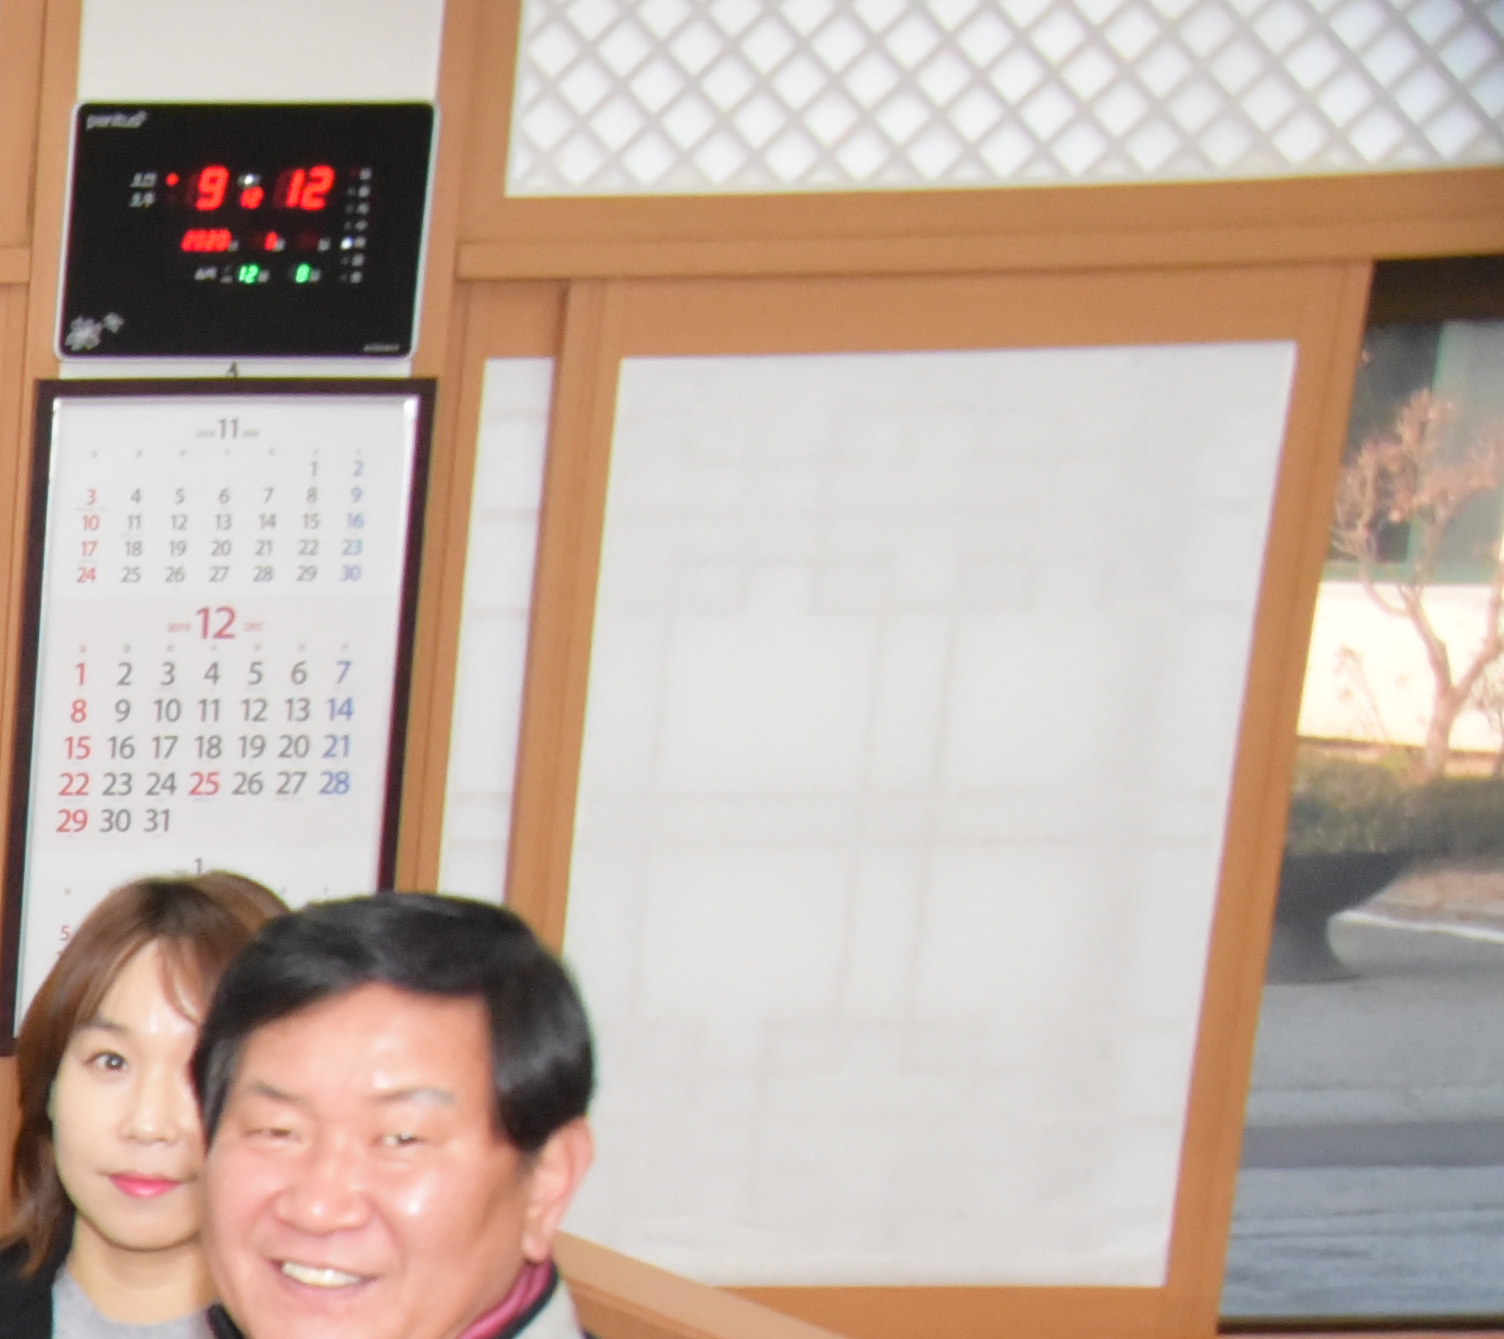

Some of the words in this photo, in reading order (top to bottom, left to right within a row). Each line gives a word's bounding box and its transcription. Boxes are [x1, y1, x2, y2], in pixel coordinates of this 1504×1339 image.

[196, 164, 230, 211] 9
[286, 164, 336, 211] 12
[238, 263, 260, 284] 12
[219, 418, 238, 438] 11
[311, 461, 318, 476] 1
[354, 460, 364, 477] 2
[87, 489, 96, 505] 3
[131, 489, 141, 503] 4
[176, 488, 185, 504] 5
[219, 488, 230, 504] 6
[264, 487, 274, 503] 7
[307, 487, 317, 503] 8
[351, 486, 362, 502] 9
[83, 515, 100, 531] 10
[128, 514, 141, 530] 11
[172, 514, 188, 530] 12
[216, 514, 232, 530] 13
[260, 514, 276, 528] 14
[303, 513, 320, 529] 15
[348, 514, 365, 528] 16
[81, 541, 98, 556] 17
[126, 541, 142, 556] 18
[170, 540, 187, 556] 19
[211, 540, 232, 556] 20
[256, 540, 272, 556] 21
[299, 539, 319, 556] 22
[342, 539, 363, 555] 23
[77, 567, 96, 583] 24
[122, 566, 141, 583] 25
[165, 566, 185, 582] 26
[209, 566, 230, 582] 27
[253, 565, 274, 582] 28
[297, 565, 317, 582] 29
[342, 565, 361, 581] 30
[197, 606, 236, 639] 12
[77, 663, 85, 685] 1
[117, 662, 132, 686] 2
[161, 662, 175, 686] 3
[204, 662, 220, 684] 4
[249, 661, 263, 685] 5
[291, 661, 307, 685] 6
[337, 660, 351, 683] 7
[71, 699, 86, 723] 8
[115, 699, 131, 722] 9
[154, 698, 181, 722] 10
[199, 699, 220, 721] 11
[242, 698, 268, 722] 12
[286, 698, 310, 721] 13
[329, 698, 354, 720] 14
[66, 736, 90, 760] 15
[108, 736, 135, 759] 16
[153, 735, 178, 759] 17
[196, 735, 222, 759] 18
[239, 735, 266, 758] 19
[278, 735, 310, 758] 20
[323, 735, 350, 758] 21
[59, 772, 89, 796] 22
[103, 772, 132, 796] 23
[146, 772, 176, 796] 24
[189, 772, 220, 795] 25
[232, 772, 263, 795] 26
[276, 771, 307, 795] 27
[319, 771, 350, 795] 28
[57, 809, 88, 832] 29
[100, 809, 131, 832] 30
[144, 809, 170, 832] 31
[61, 926, 69, 940] 5
